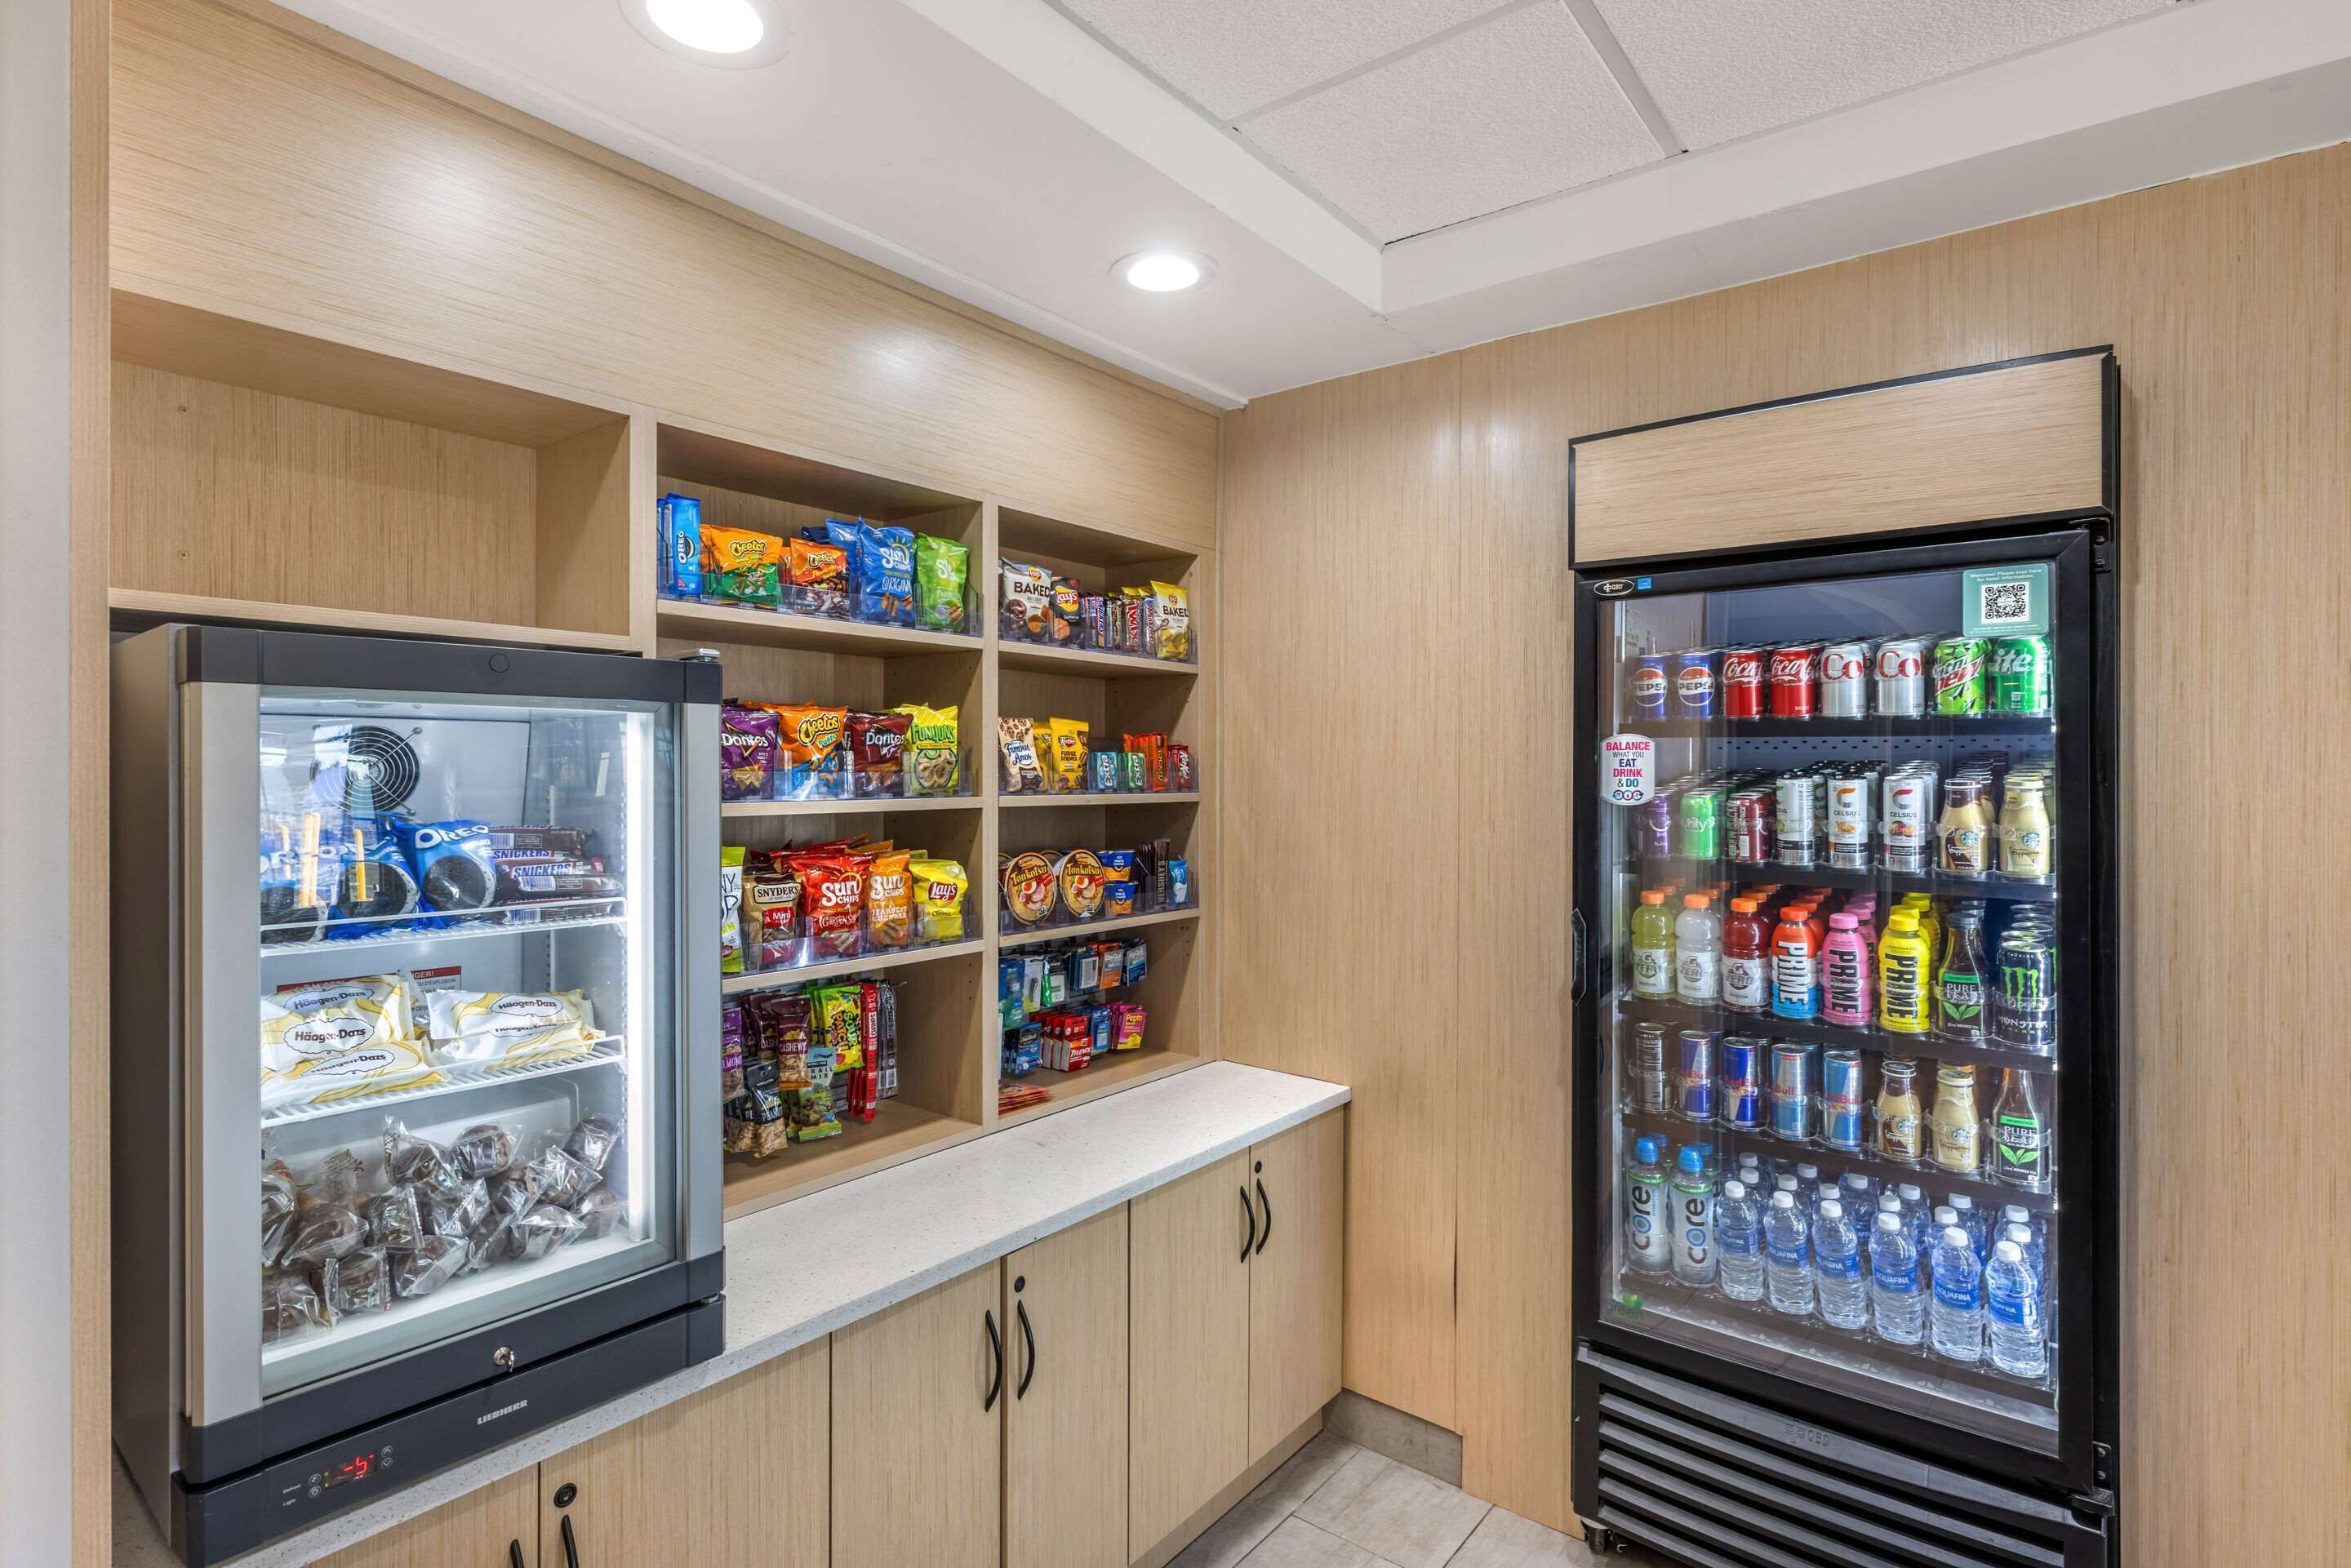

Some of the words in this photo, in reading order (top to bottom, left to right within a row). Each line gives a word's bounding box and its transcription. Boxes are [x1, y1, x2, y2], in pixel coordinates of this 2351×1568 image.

[678, 531, 687, 564] OREO
[1014, 581, 1051, 597] BAKED
[1822, 653, 1864, 680] Co
[1997, 649, 2033, 674] ite
[1635, 682, 1666, 692] EPSI
[798, 713, 840, 746] Cheetos
[721, 733, 768, 746] Doritos
[1606, 741, 1651, 751] BALANCE
[1613, 768, 1643, 777] DRINK
[1617, 779, 1624, 787] &
[1625, 779, 1638, 787] DO
[415, 825, 489, 849] OREO
[493, 850, 549, 860] SNICKERS
[513, 863, 572, 879] SNICKERS
[1011, 865, 1047, 884] Tonkotsu
[1067, 864, 1101, 875] Tonkotsu
[757, 886, 799, 897] SNYDER'S
[821, 880, 858, 906] Sun
[870, 874, 903, 899] Sun
[930, 882, 957, 901] Lay's
[837, 895, 860, 904] CHIPS
[1777, 940, 1808, 1006] PRIME
[1829, 948, 1860, 1014] PRIME
[1885, 953, 1918, 1019] PRIME
[1947, 983, 1976, 993] PURE
[294, 991, 367, 1009] Häagen-Dazs
[499, 1000, 557, 1009] Häagen-Dazs
[835, 1012, 850, 1052] PATCH
[843, 1011, 859, 1046] SOUR
[1775, 1084, 1794, 1095] Bull
[2004, 1126, 2036, 1136] PURE
[1632, 1185, 1651, 1250] core
[1686, 1197, 1707, 1264] core
[478, 1399, 528, 1425] LIEBHERR
